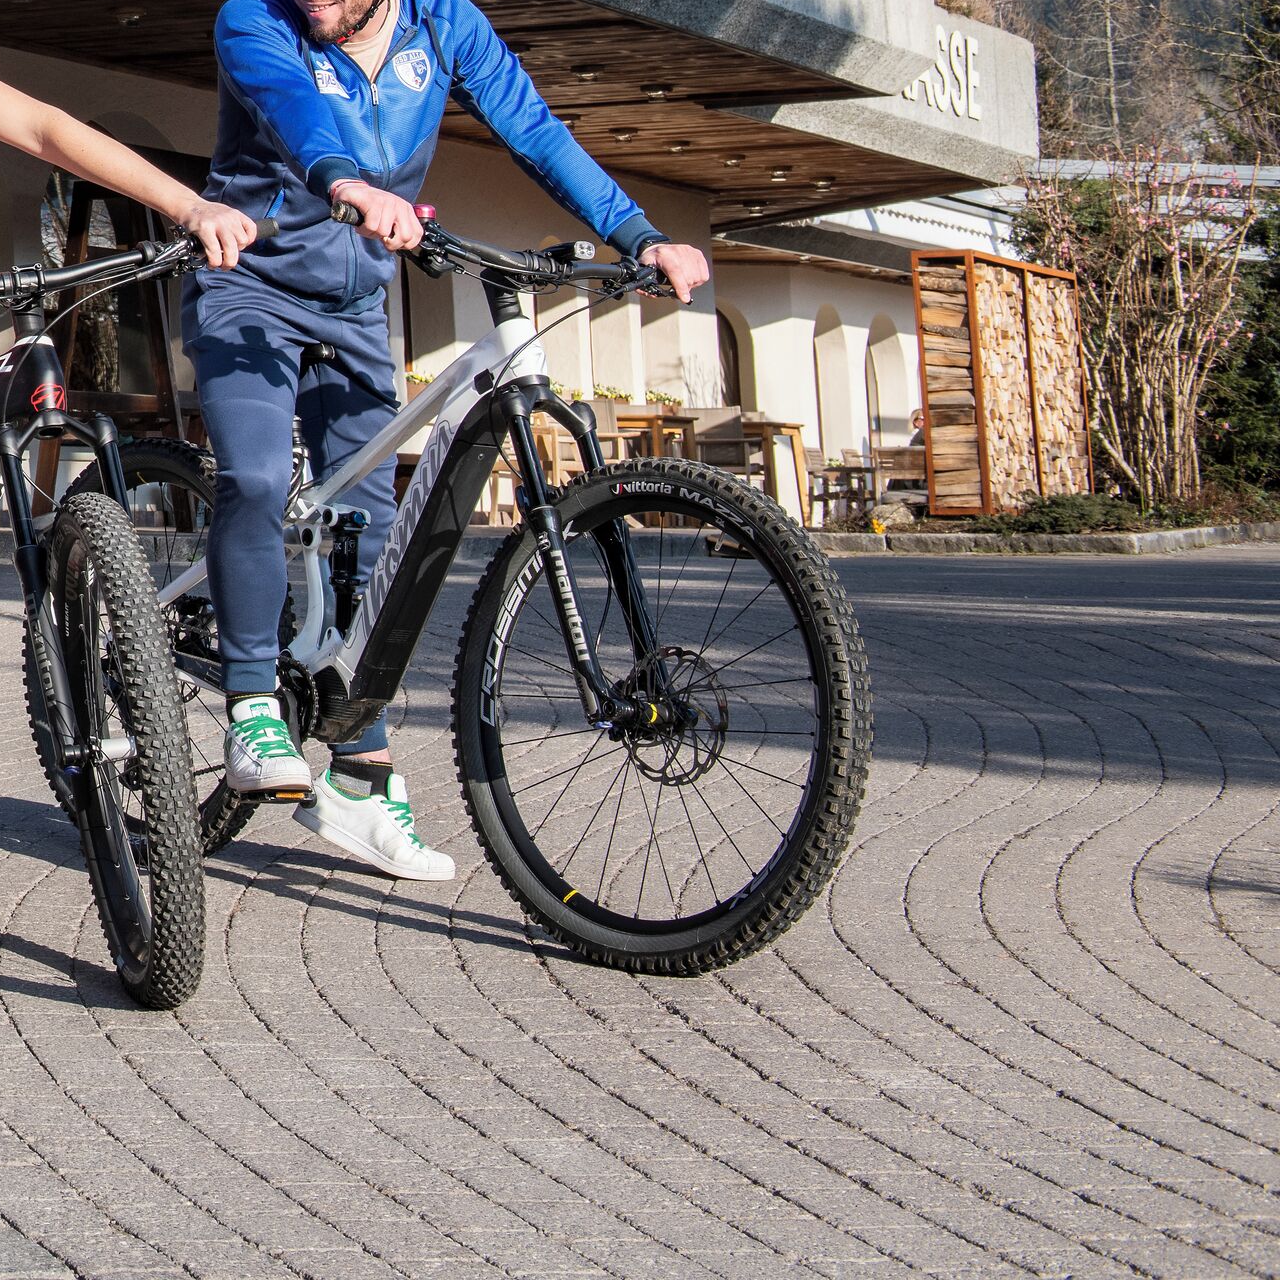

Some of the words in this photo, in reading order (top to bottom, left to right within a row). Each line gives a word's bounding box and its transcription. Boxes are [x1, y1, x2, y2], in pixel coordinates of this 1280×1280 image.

[620, 481, 674, 495] vittoria
[679, 488, 755, 541] MAZZA
[480, 520, 586, 728] CROSSMX
[551, 550, 590, 662] manitou
